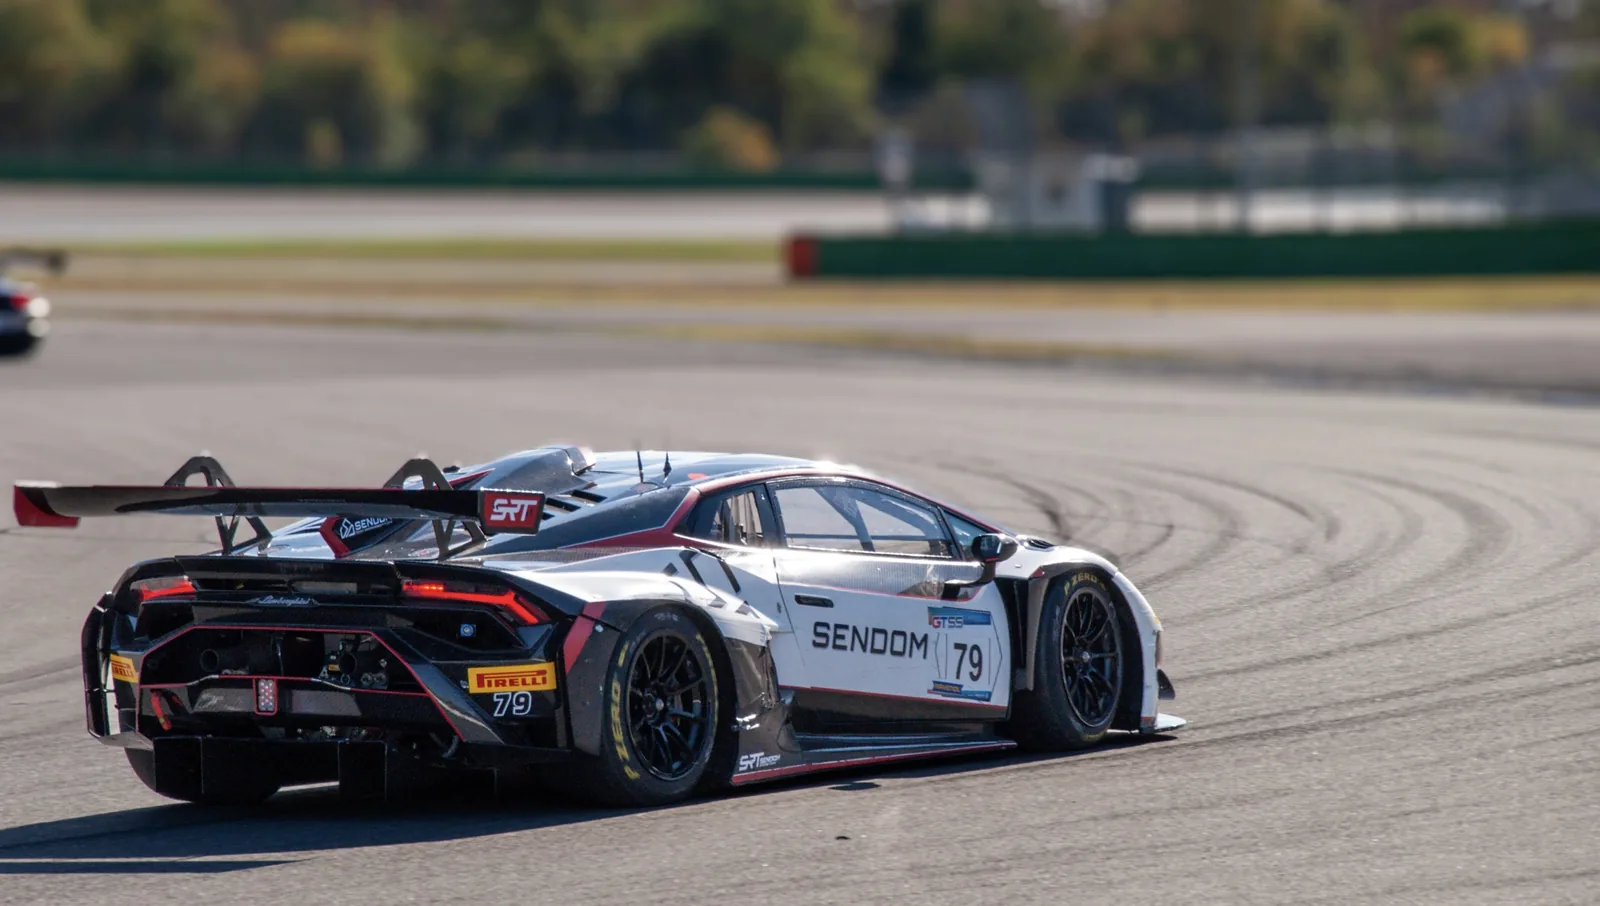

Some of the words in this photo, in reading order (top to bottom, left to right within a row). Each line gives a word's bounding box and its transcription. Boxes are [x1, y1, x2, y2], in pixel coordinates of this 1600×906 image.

[490, 499, 538, 521] SRT
[1071, 572, 1098, 586] ZERO
[932, 616, 963, 629] GTSS
[812, 621, 928, 659] SENDOM
[111, 660, 134, 678] IRELLI
[954, 642, 983, 682] 79
[476, 669, 547, 688] PIRELLI
[493, 691, 532, 716] 79
[610, 679, 630, 761] ZERO
[739, 752, 764, 771] SRT
